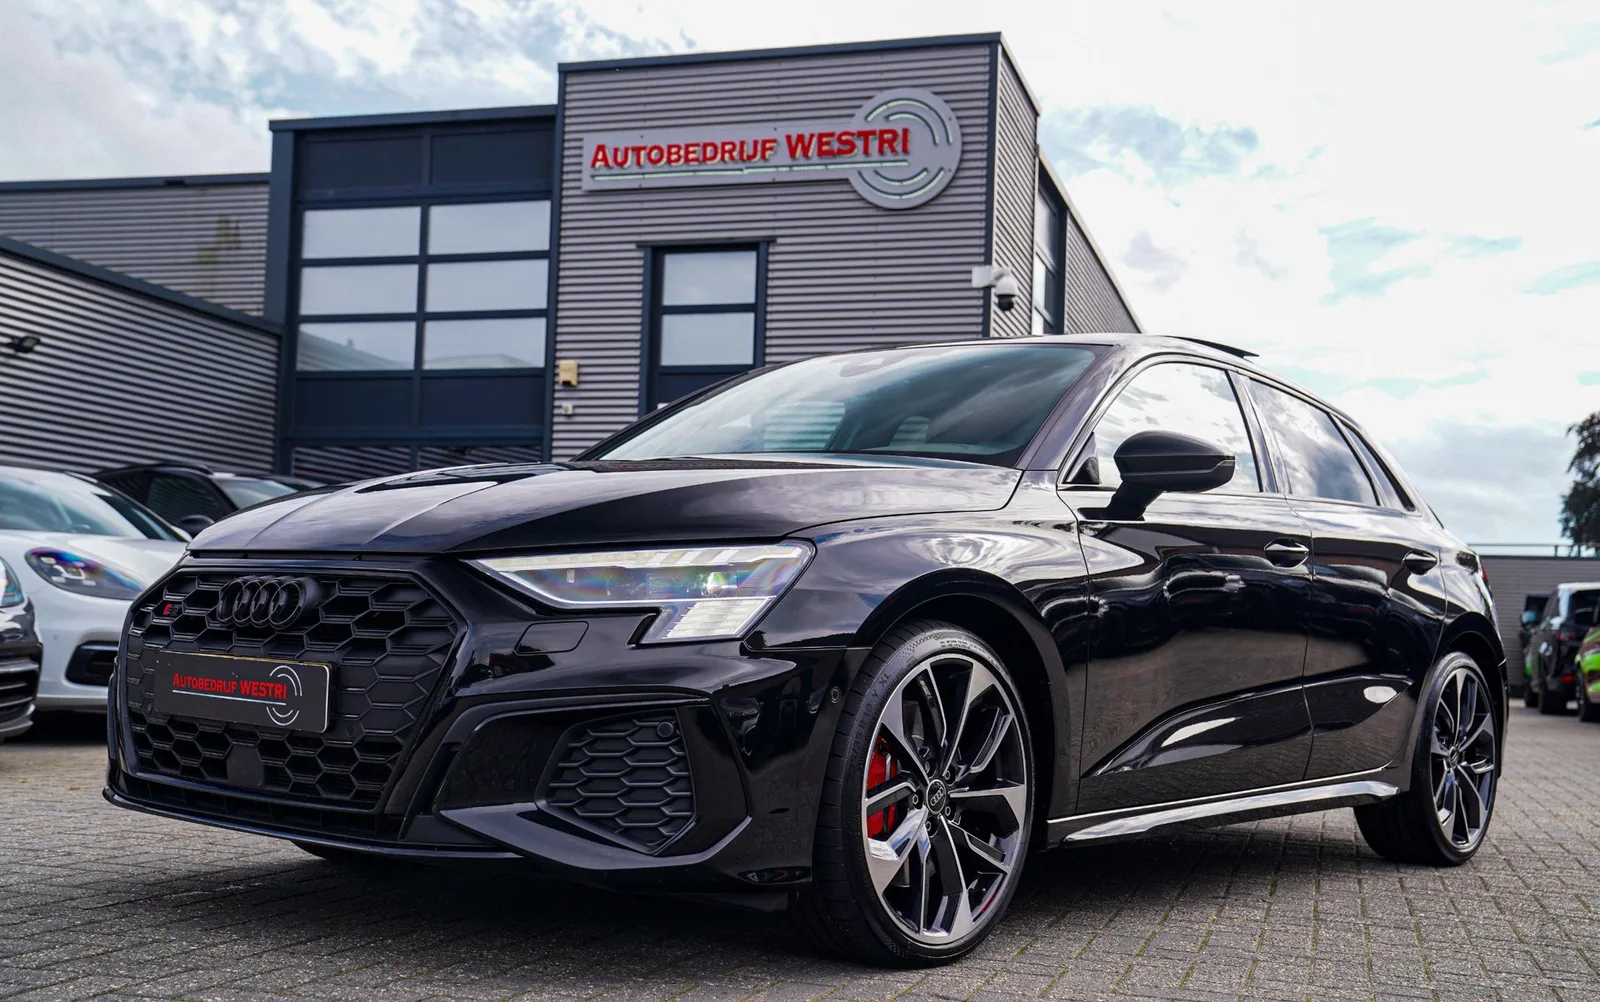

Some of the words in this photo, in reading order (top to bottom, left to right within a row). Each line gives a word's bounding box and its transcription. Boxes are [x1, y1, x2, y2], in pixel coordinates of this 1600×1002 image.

[590, 138, 778, 169] AUTOBEDRIJF
[784, 127, 910, 159] WESTRI
[172, 672, 238, 693] AUTOBEDRIJF
[240, 679, 287, 699] WESTRI
[878, 672, 892, 688] XL
